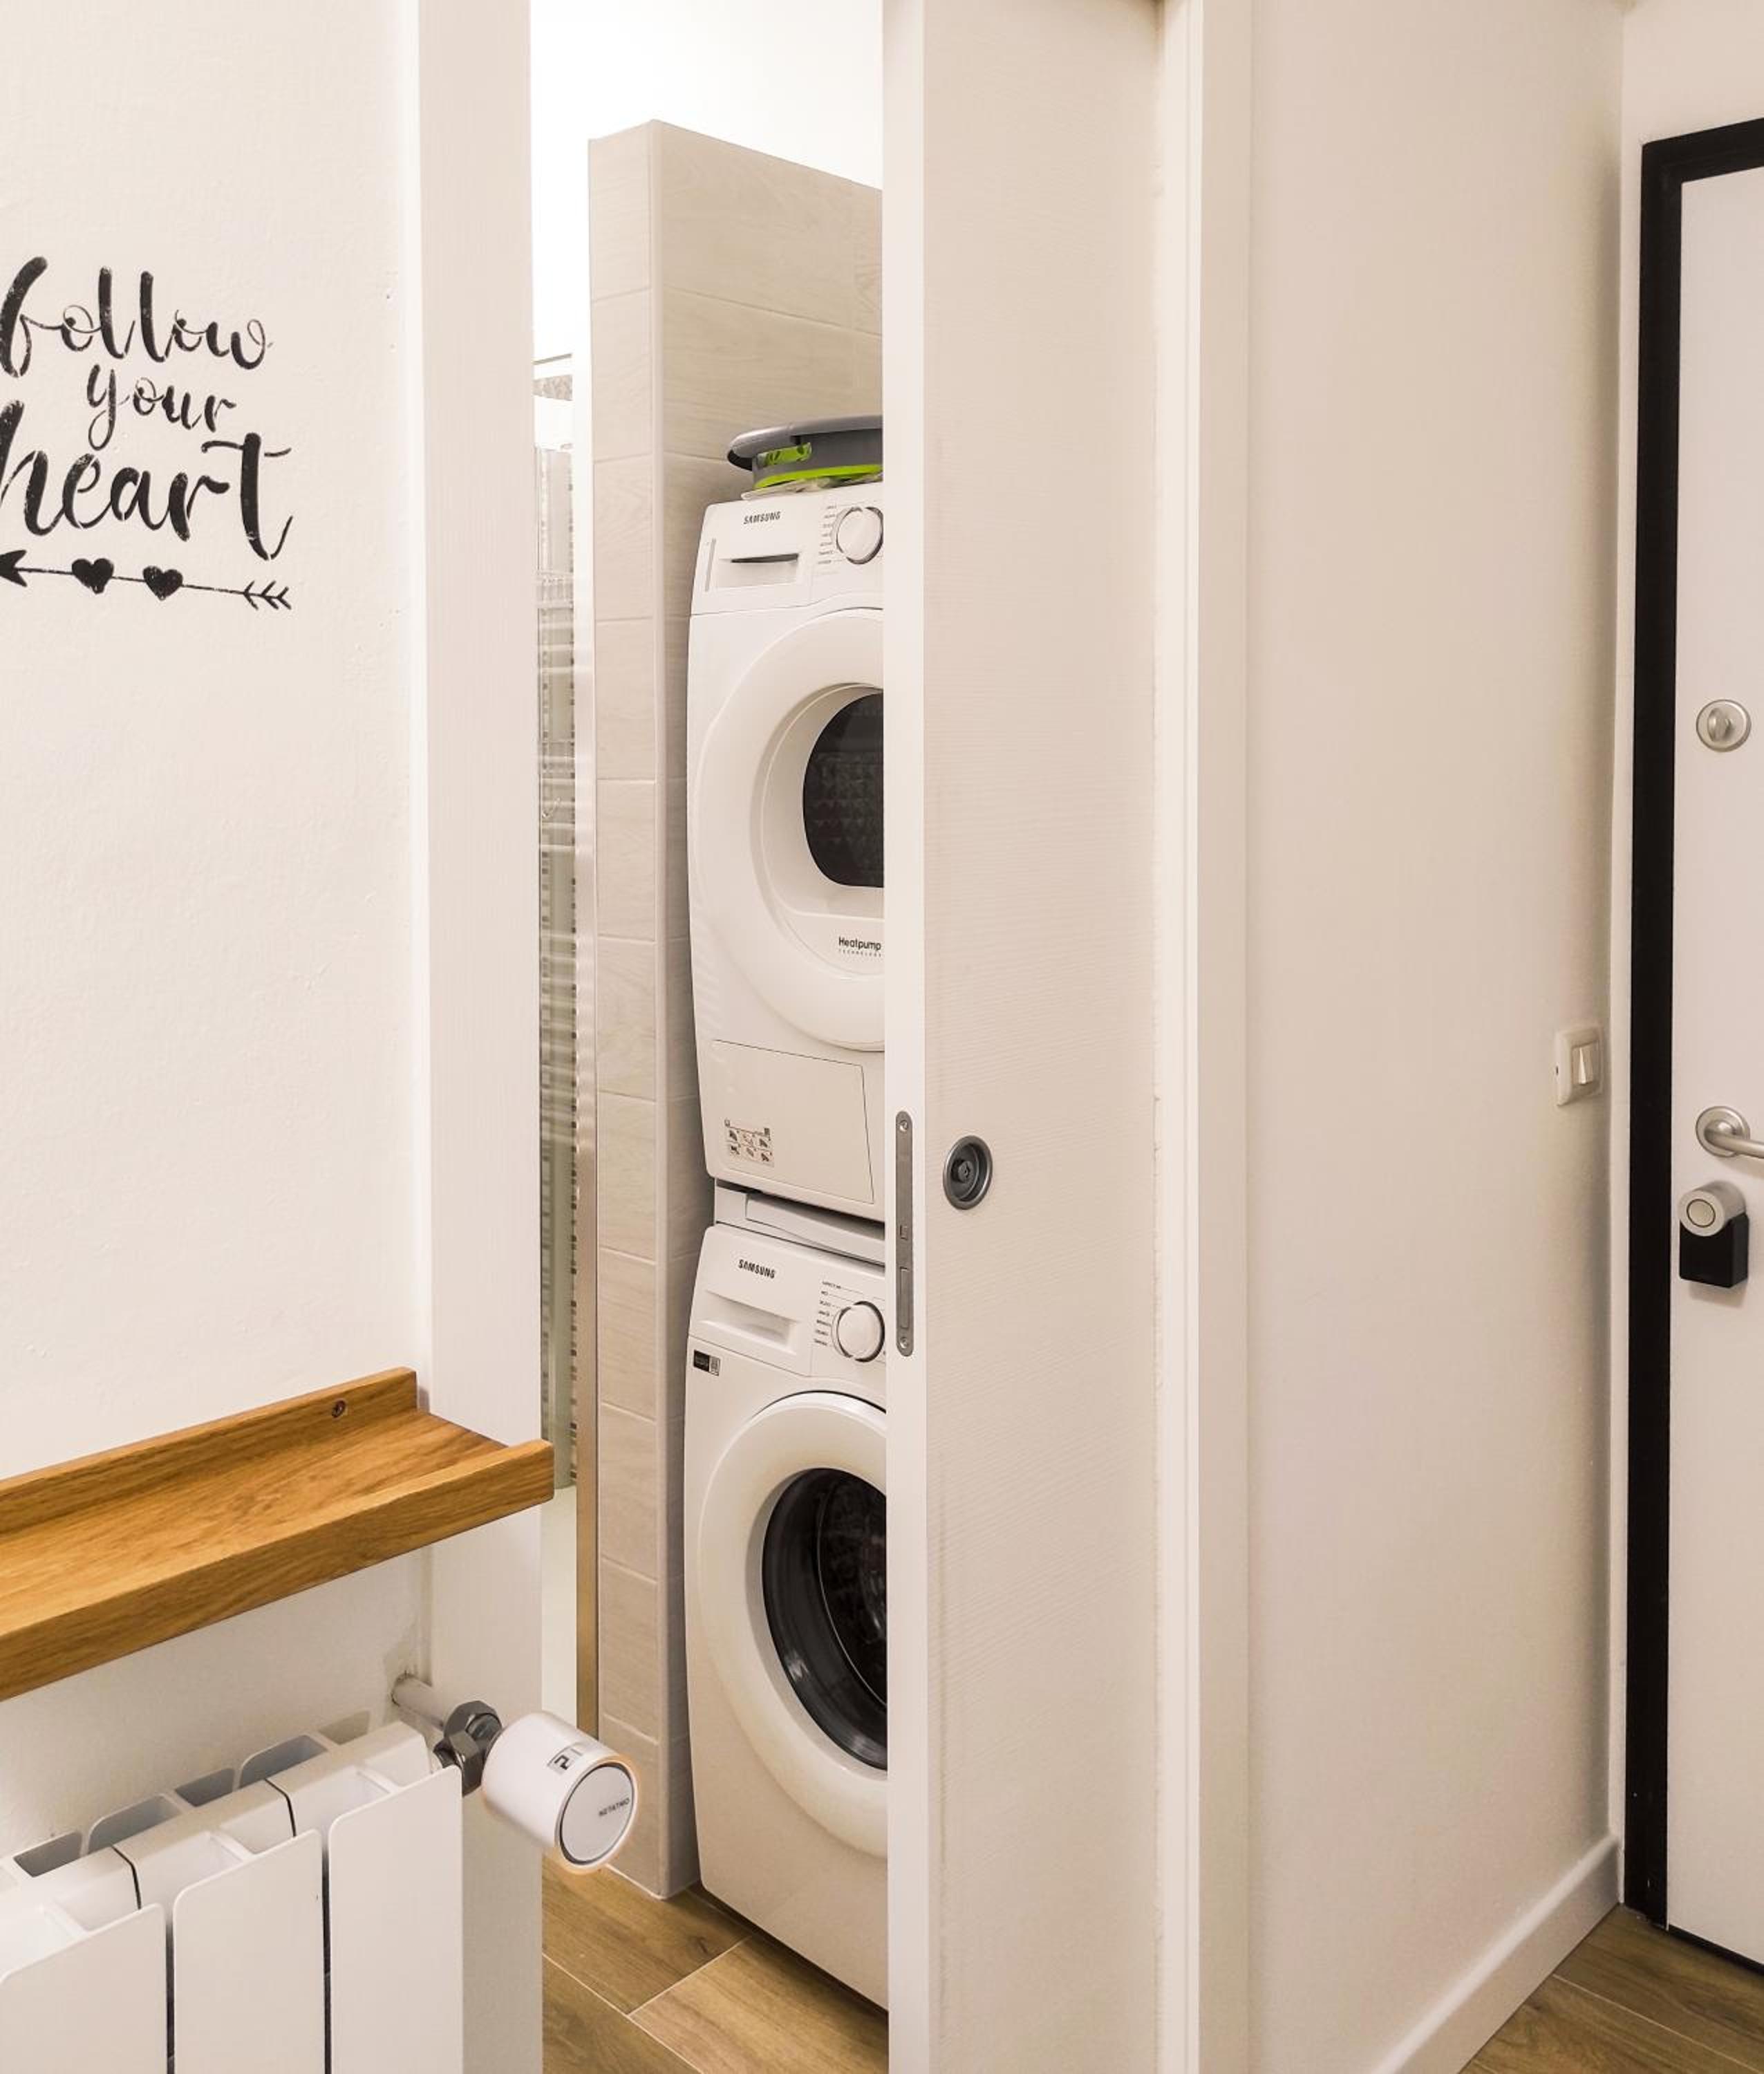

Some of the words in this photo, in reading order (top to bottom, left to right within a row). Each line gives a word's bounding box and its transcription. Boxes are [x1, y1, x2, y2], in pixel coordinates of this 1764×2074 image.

[0, 256, 273, 377] follow
[86, 364, 237, 451] your
[742, 510, 781, 525] SAMSUNG
[838, 936, 882, 952] Heatpump
[738, 1259, 776, 1279] SAMSUNG
